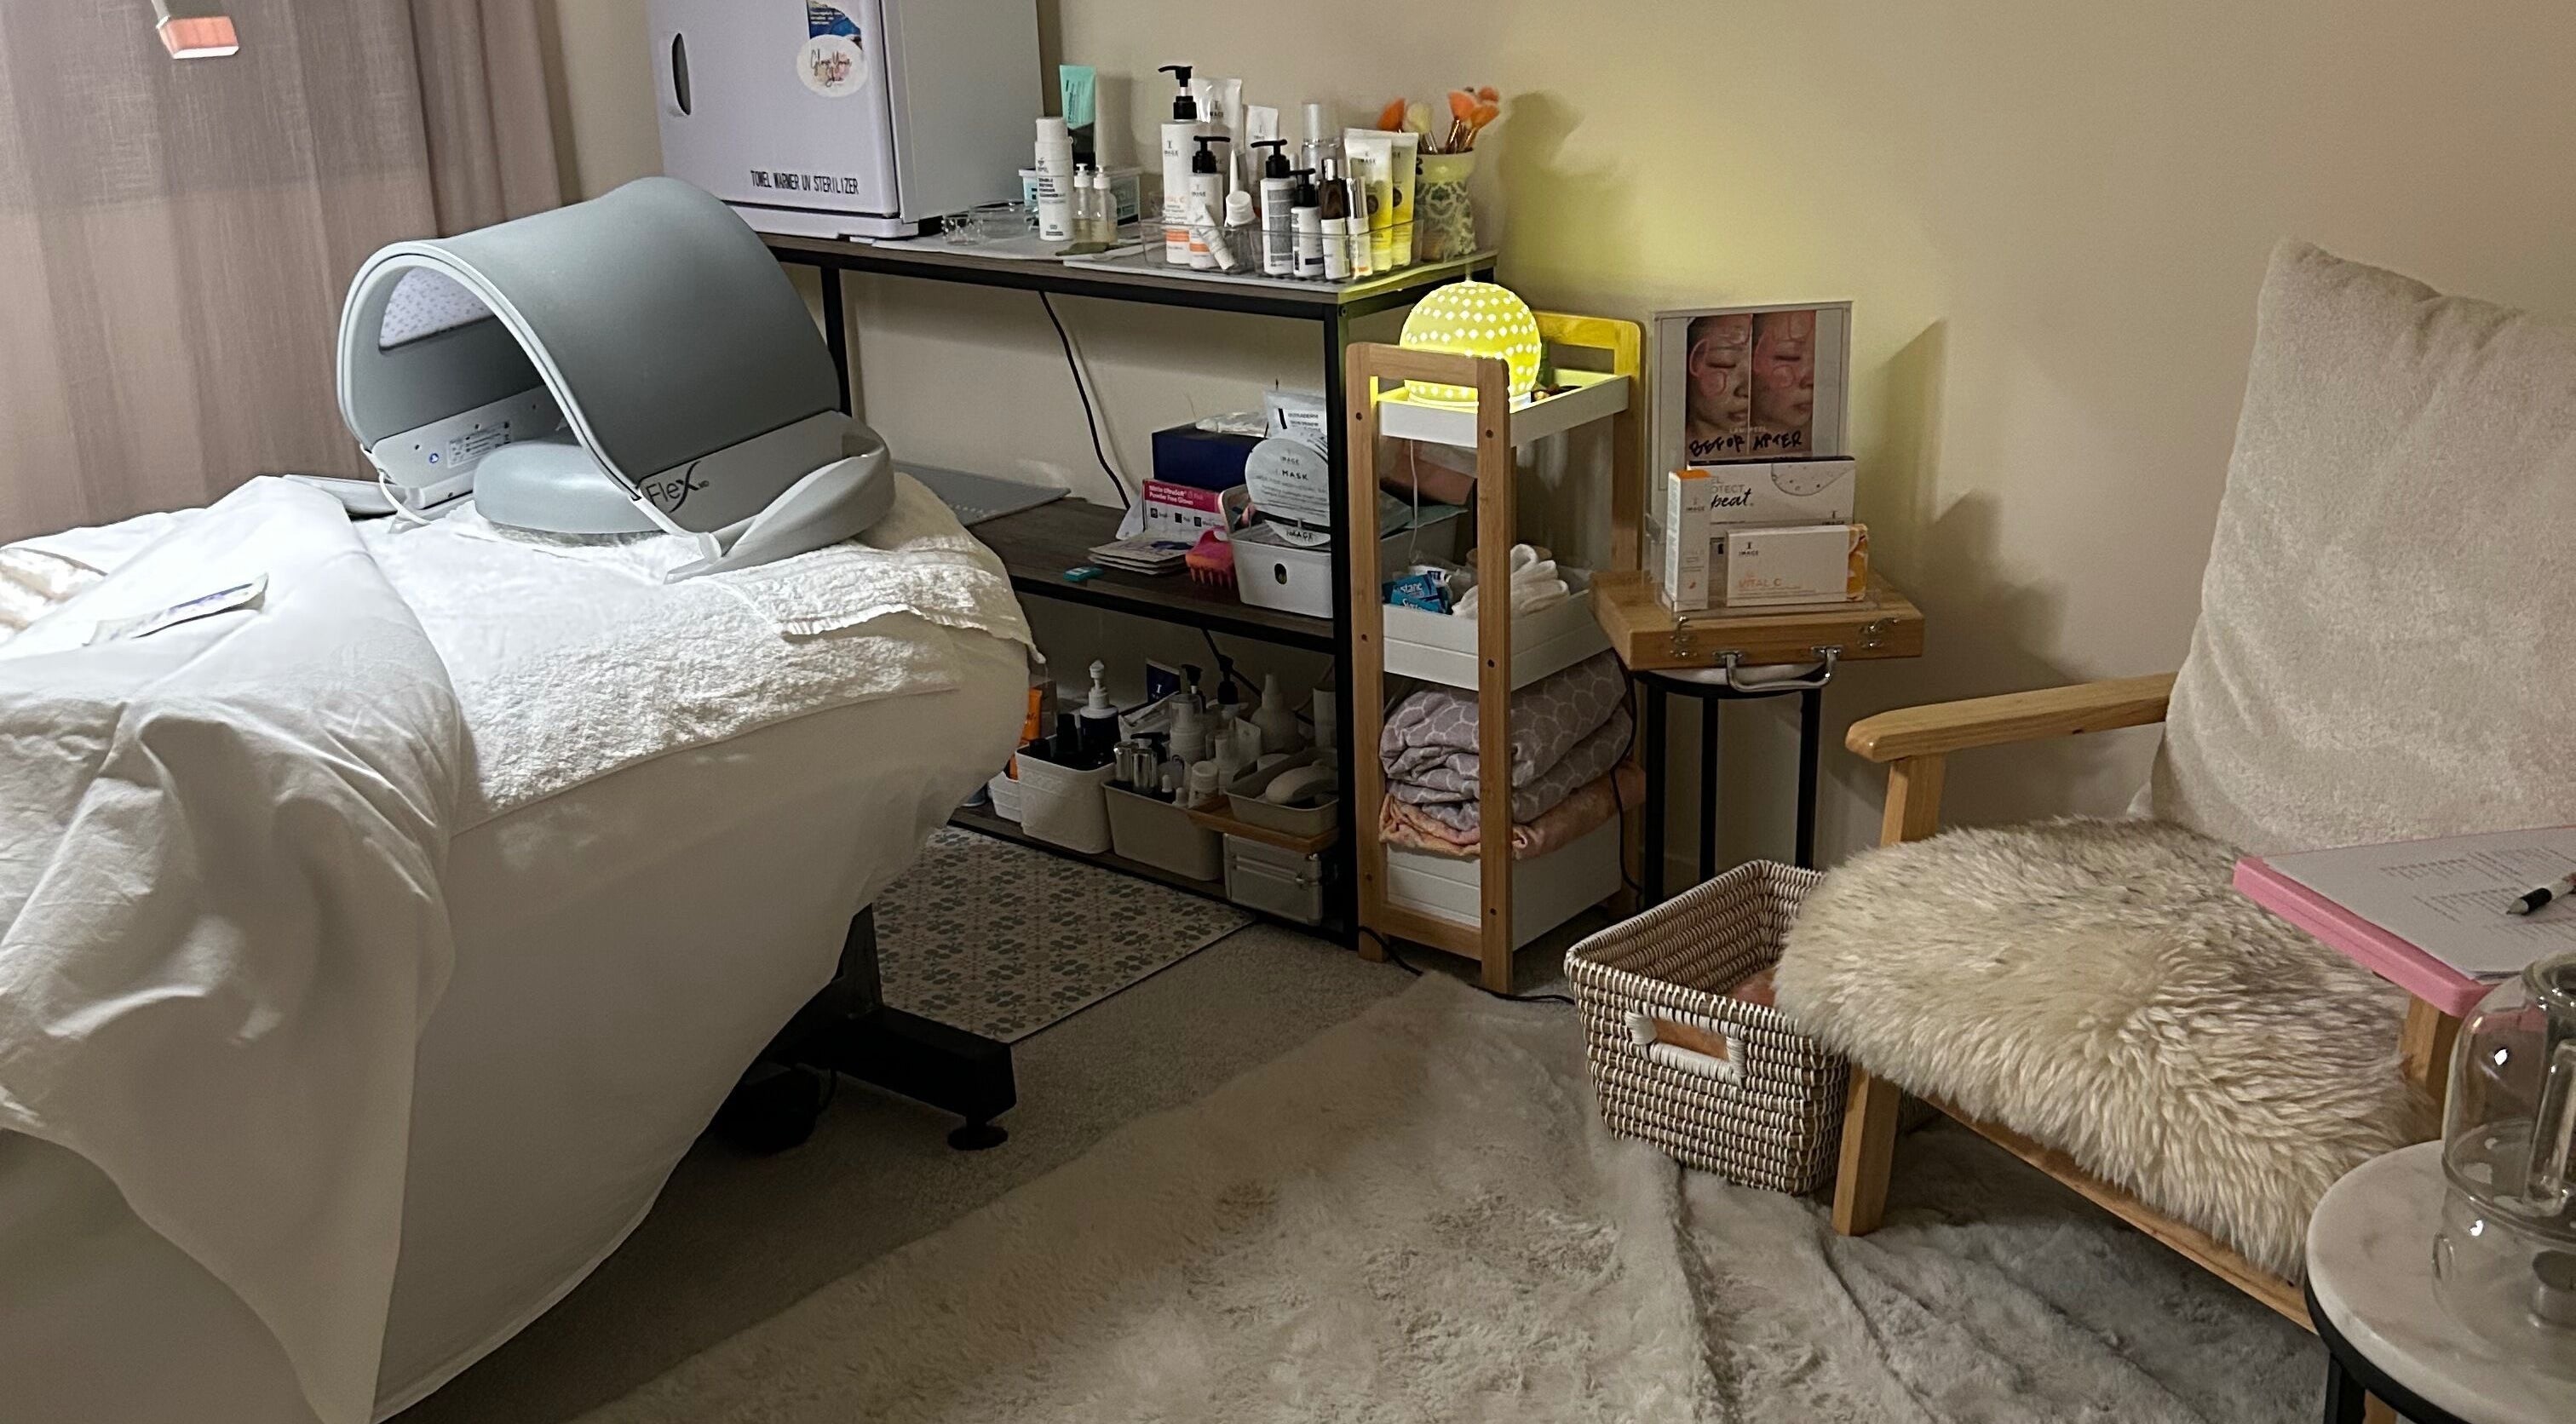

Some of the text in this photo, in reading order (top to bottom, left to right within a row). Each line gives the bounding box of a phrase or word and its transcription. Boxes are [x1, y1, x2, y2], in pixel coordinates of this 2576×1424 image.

[750, 169, 860, 195] TOWEL WARMER UV STERILIZER
[1752, 430, 1803, 451] AFTER
[1280, 456, 1300, 465] IMAGE
[1281, 470, 1309, 480] MASK
[1710, 484, 1745, 494] OTECT
[1285, 529, 1314, 540] IMAGE
[1738, 578, 1782, 588] VITAL C
